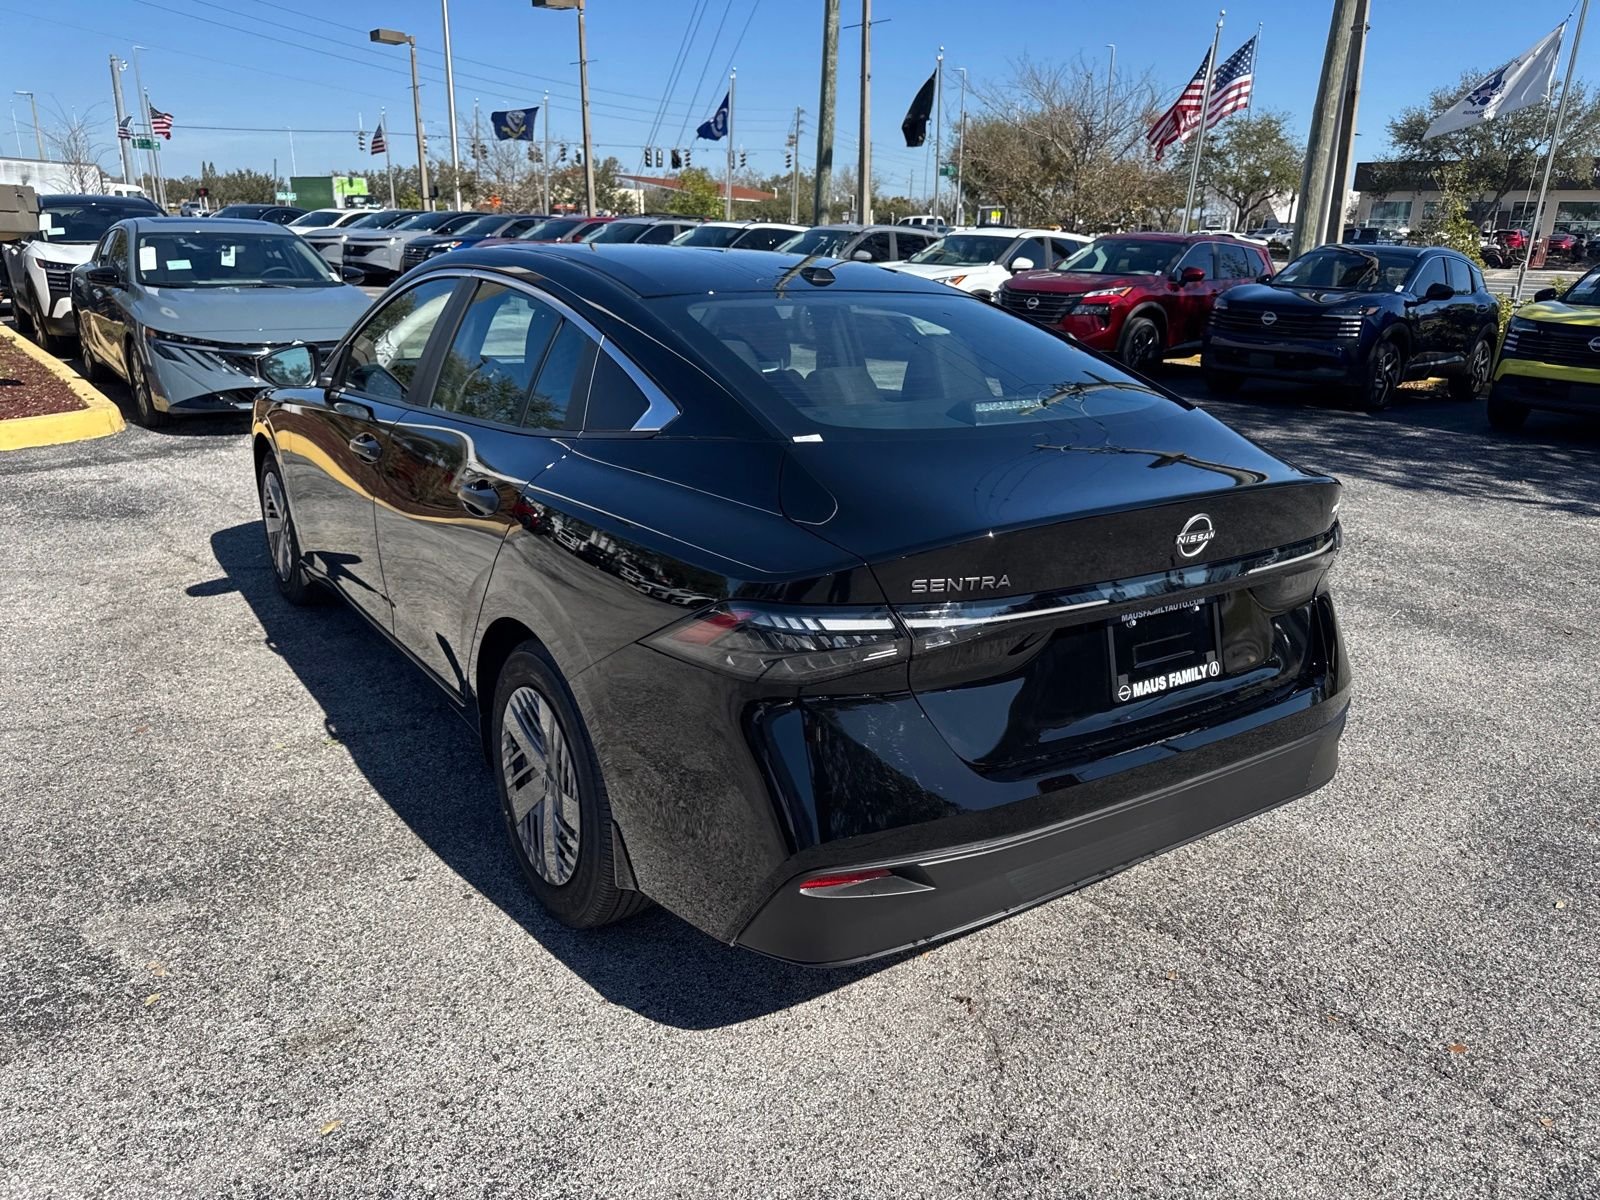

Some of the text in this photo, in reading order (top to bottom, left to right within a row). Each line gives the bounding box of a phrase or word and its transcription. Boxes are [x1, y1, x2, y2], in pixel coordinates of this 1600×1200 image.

[1177, 530, 1215, 544] NISSAN
[911, 574, 1011, 593] SENTRA
[1132, 664, 1208, 698] MAUS FAMILY
